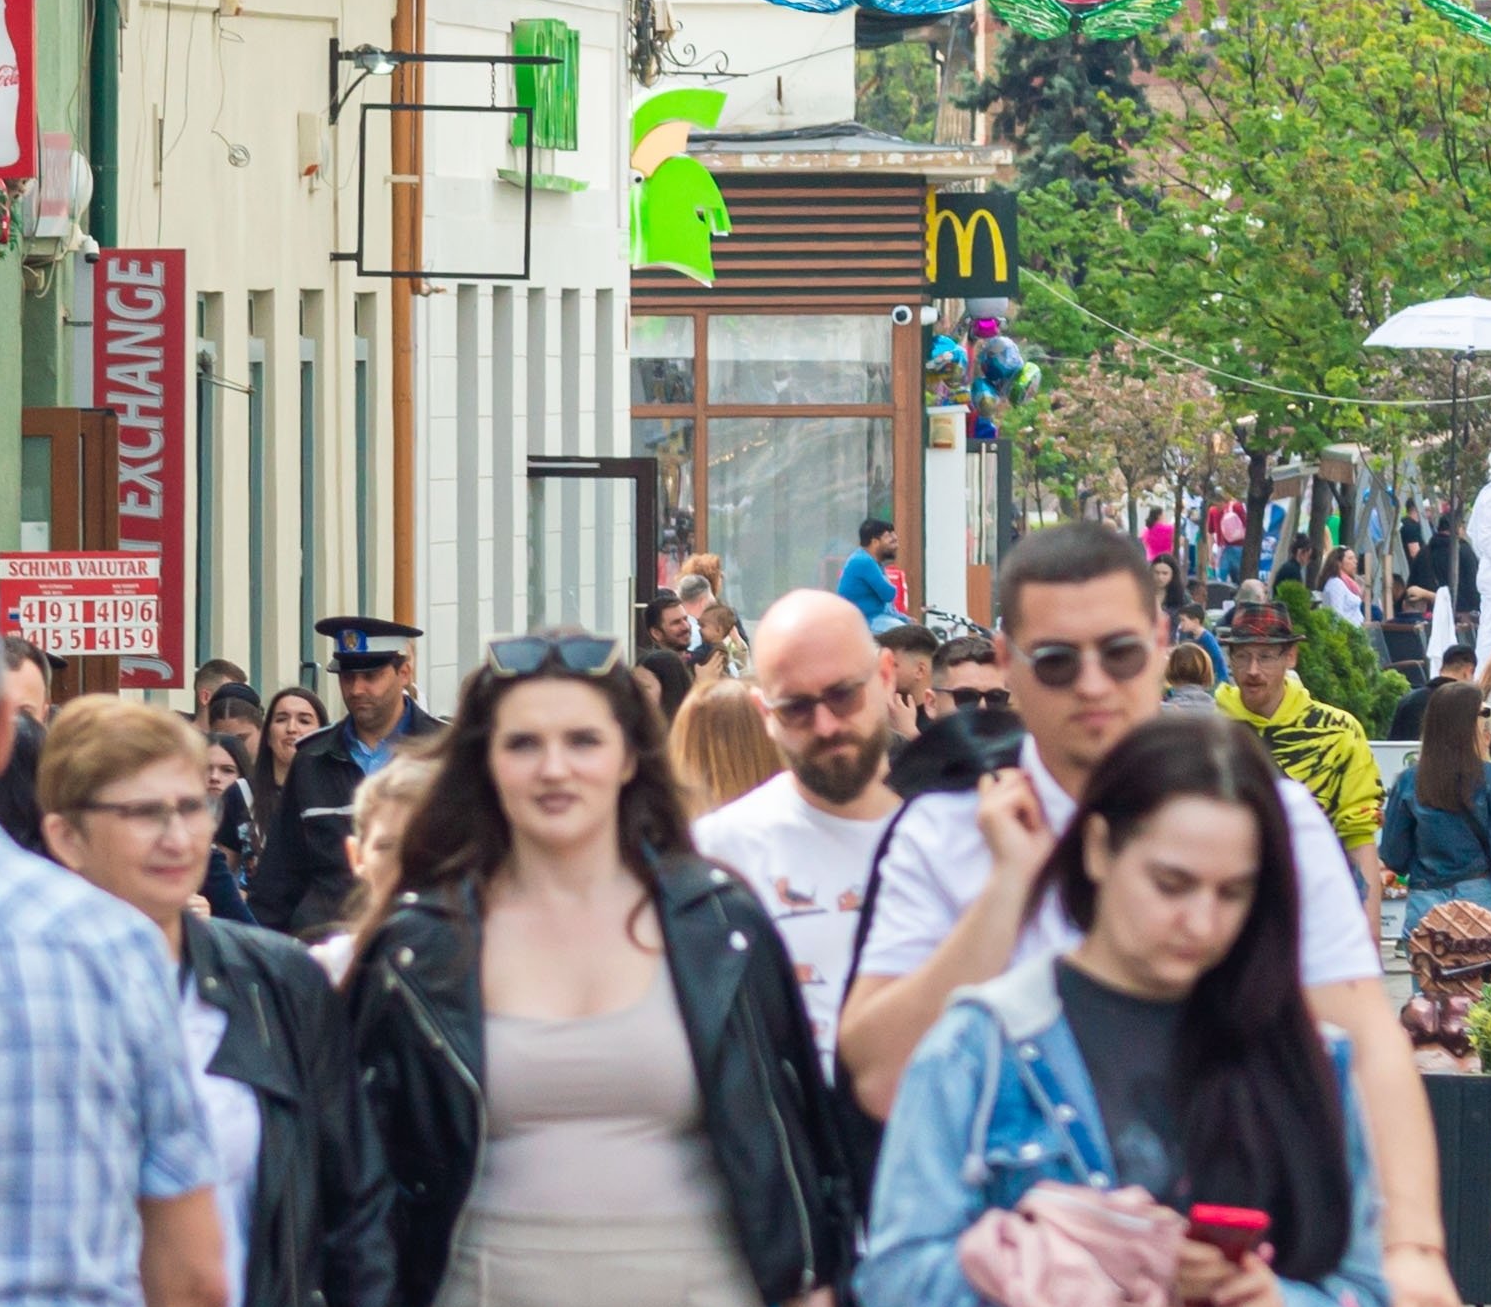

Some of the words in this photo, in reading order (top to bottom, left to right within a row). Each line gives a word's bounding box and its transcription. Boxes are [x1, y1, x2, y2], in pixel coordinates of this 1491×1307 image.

[106, 258, 166, 520] EXCHANGE
[9, 560, 73, 577] SCHIMB
[77, 560, 149, 577] VALUTAR
